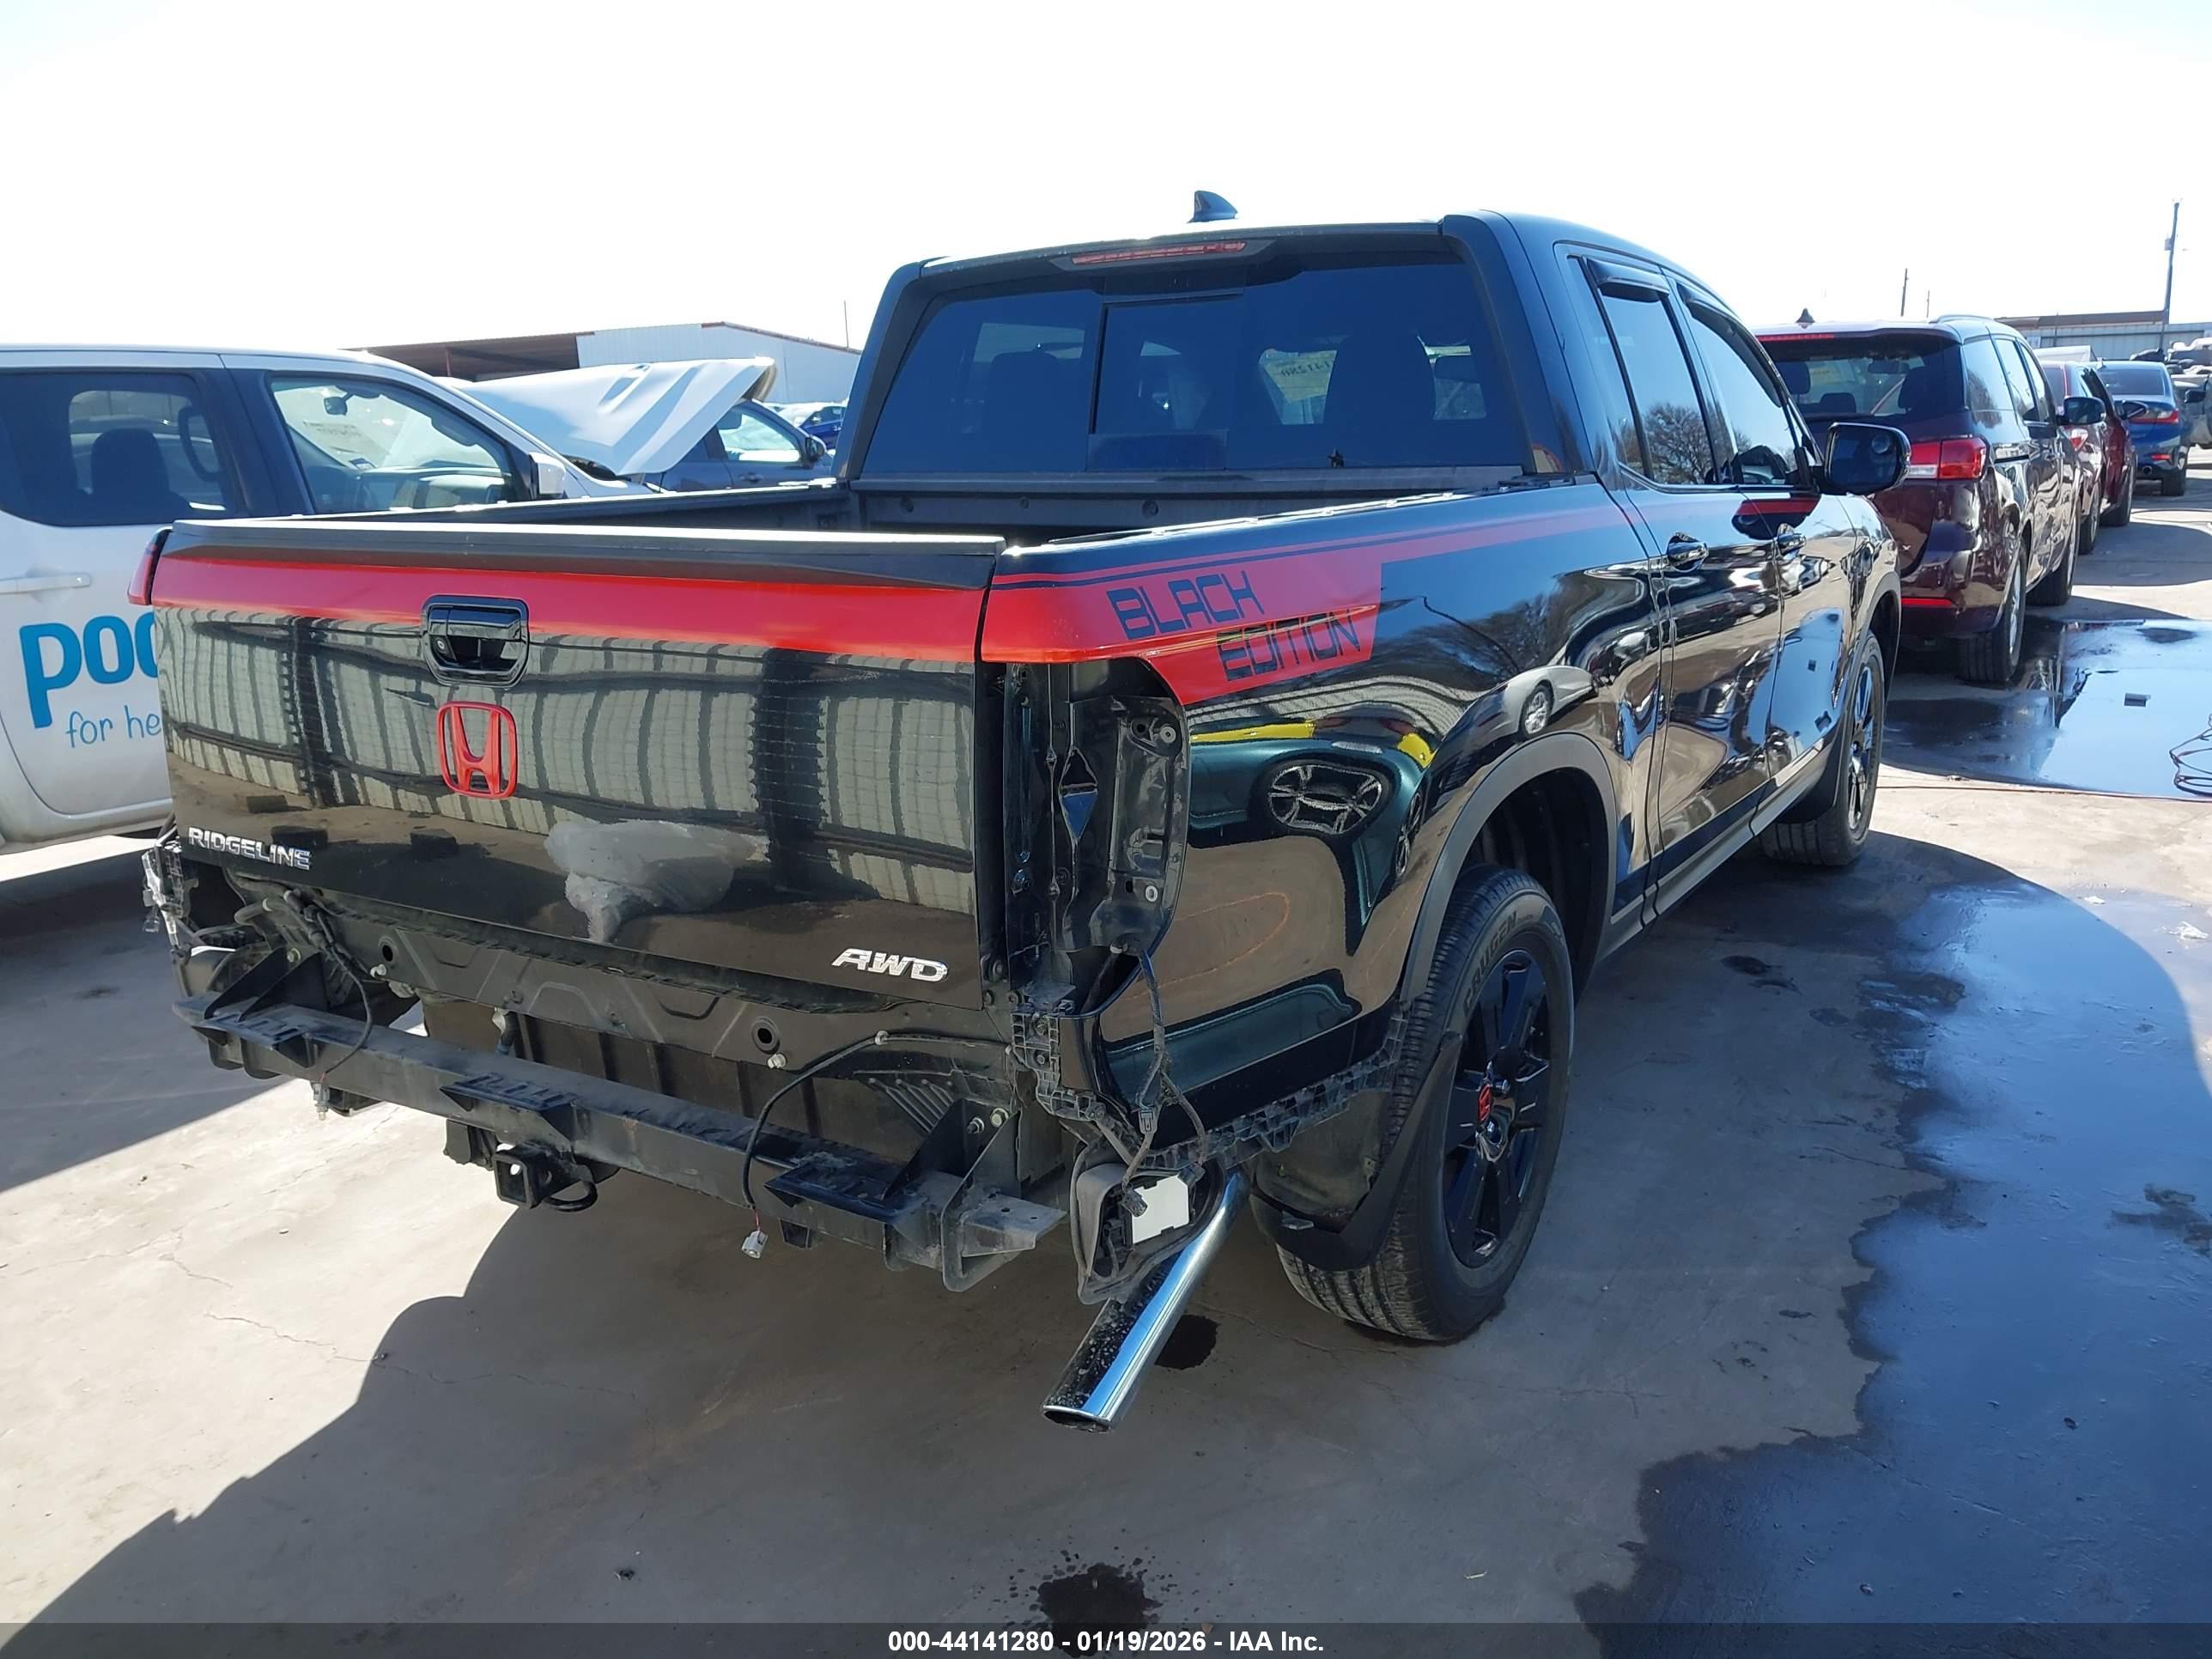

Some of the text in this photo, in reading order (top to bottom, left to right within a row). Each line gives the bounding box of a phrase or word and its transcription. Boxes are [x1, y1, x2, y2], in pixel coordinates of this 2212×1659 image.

[1216, 608, 1360, 682] EDITION
[66, 711, 113, 748] for
[188, 826, 311, 871] RIDGELINE
[831, 948, 948, 982] AWD
